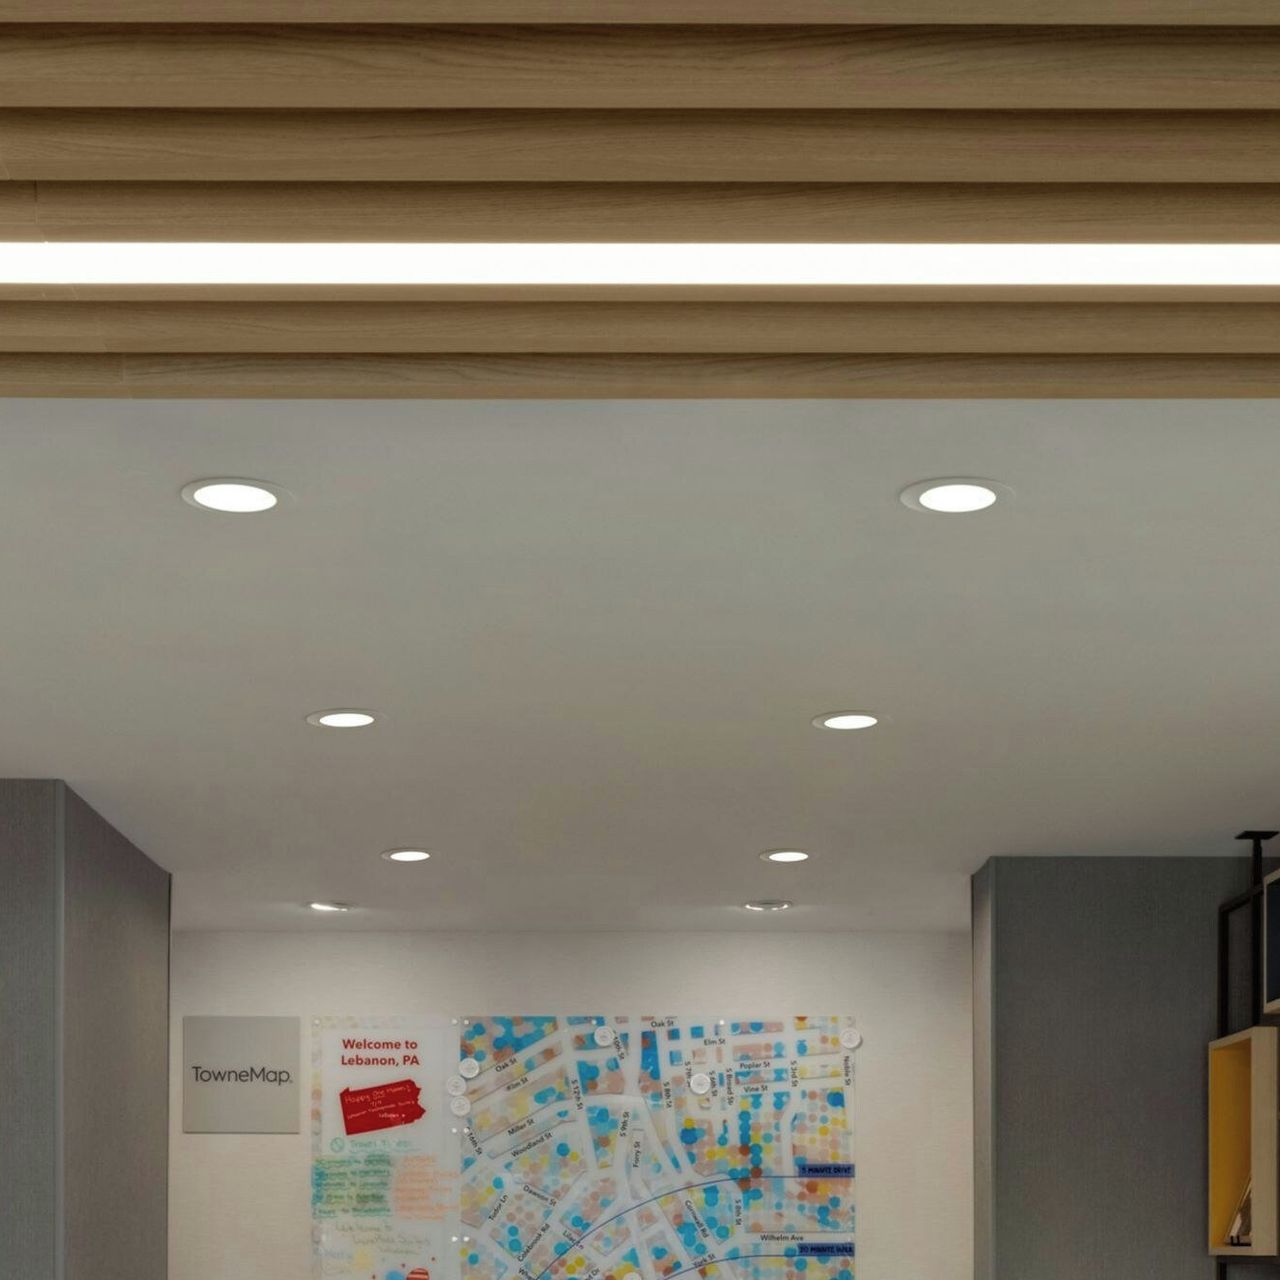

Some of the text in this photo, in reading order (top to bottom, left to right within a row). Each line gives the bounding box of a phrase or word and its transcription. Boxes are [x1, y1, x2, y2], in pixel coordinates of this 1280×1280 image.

[342, 1039, 418, 1049] Welcome to
[341, 1055, 420, 1066] Lebanon, PA
[740, 1062, 761, 1070] Poplar
[845, 1078, 851, 1086] St
[712, 1089, 718, 1097] St
[576, 1102, 583, 1110] St
[475, 1147, 482, 1155] St
[511, 1137, 545, 1157] Woodland
[500, 1194, 508, 1203] Ln
[541, 1223, 550, 1232] Rd
[701, 1228, 709, 1238] Rd
